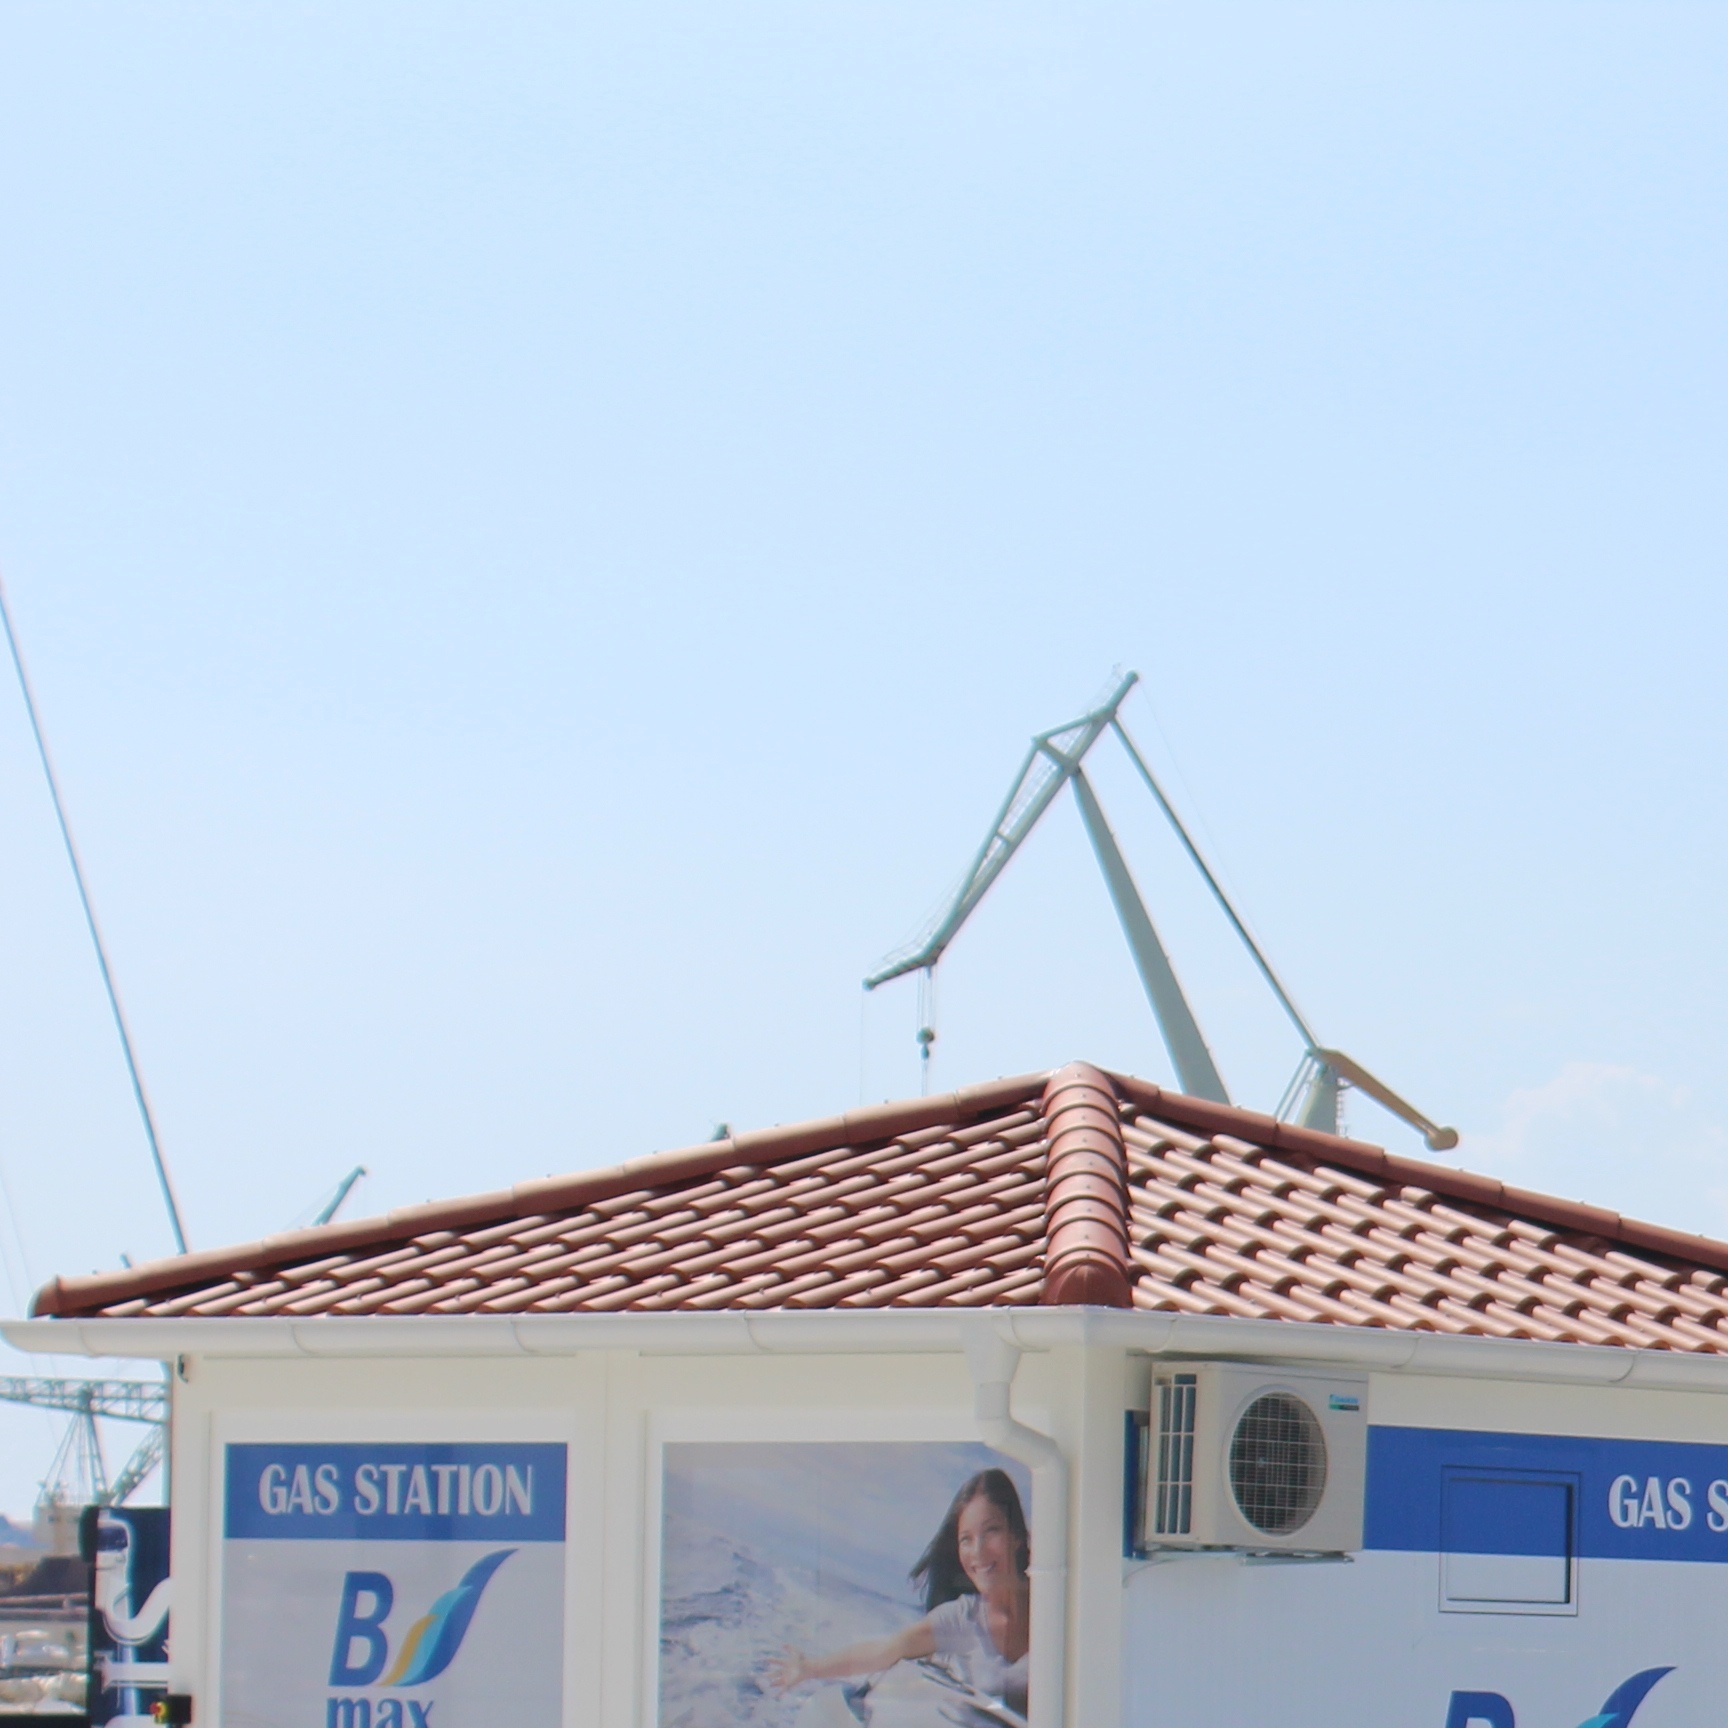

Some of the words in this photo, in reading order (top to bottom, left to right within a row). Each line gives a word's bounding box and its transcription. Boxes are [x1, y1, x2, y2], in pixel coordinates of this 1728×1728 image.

[258, 1463, 341, 1516] GAS
[354, 1463, 533, 1517] STATION
[1608, 1474, 1693, 1531] GAS
[328, 1570, 394, 1687] B
